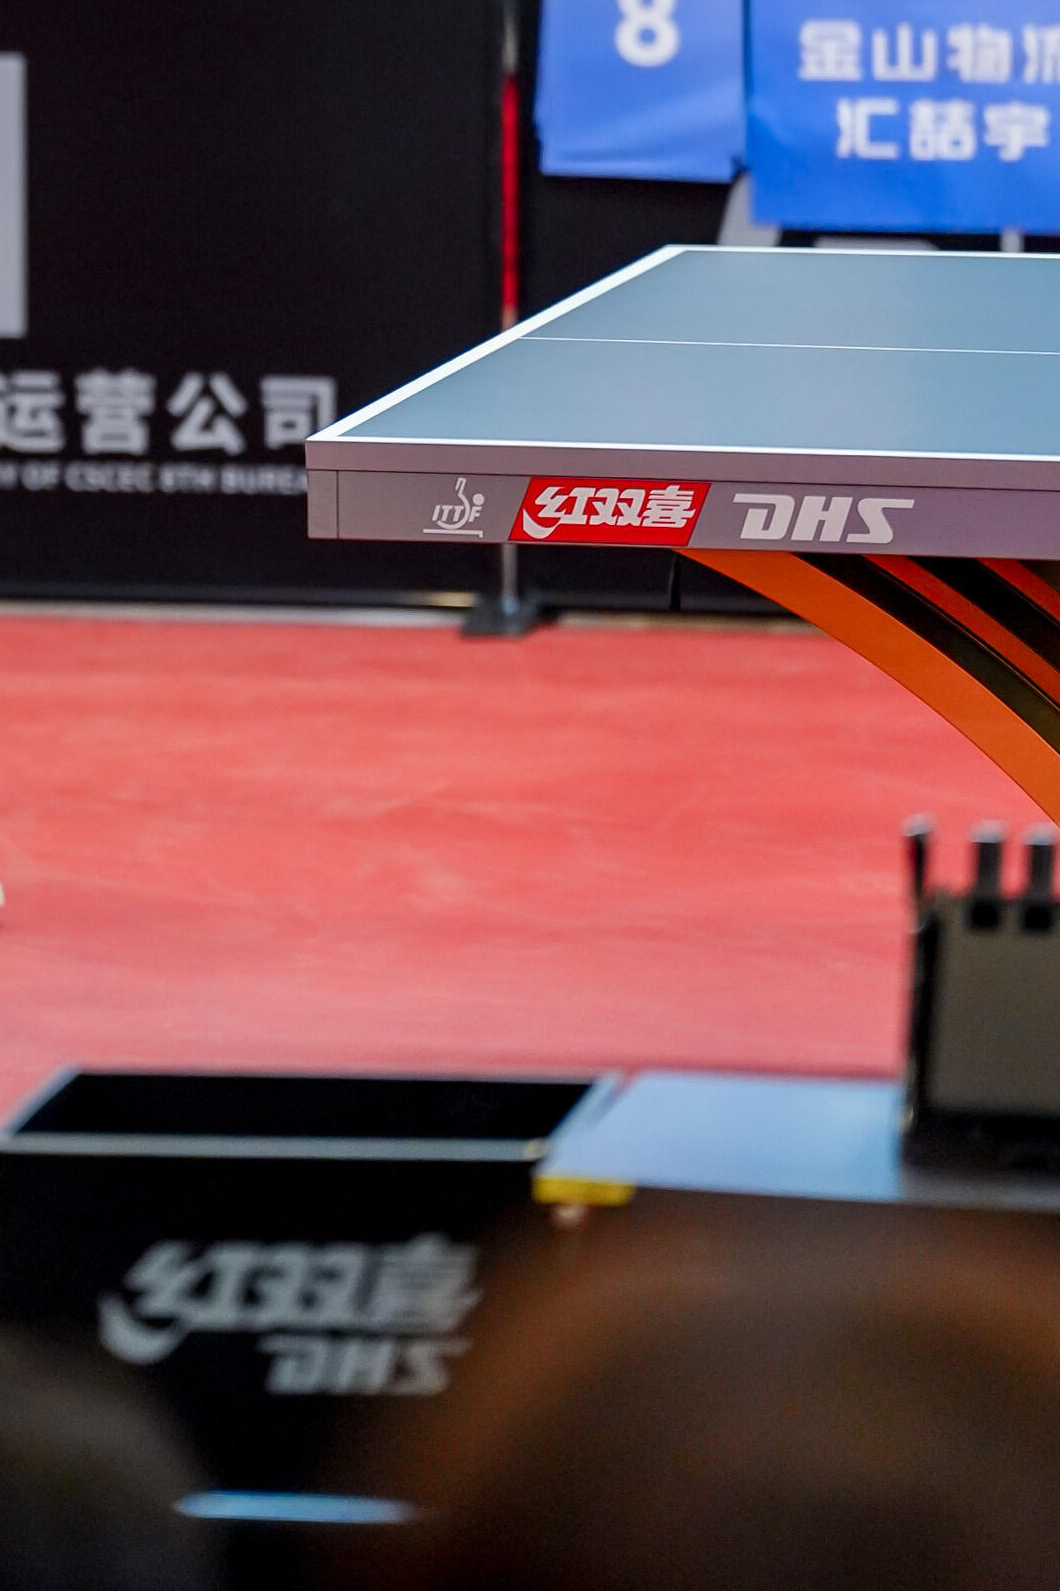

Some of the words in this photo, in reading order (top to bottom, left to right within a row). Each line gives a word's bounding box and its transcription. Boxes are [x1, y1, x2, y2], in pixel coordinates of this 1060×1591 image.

[523, 484, 696, 539] 红双喜
[733, 493, 916, 544] DHS
[255, 1335, 471, 1396] DHS
